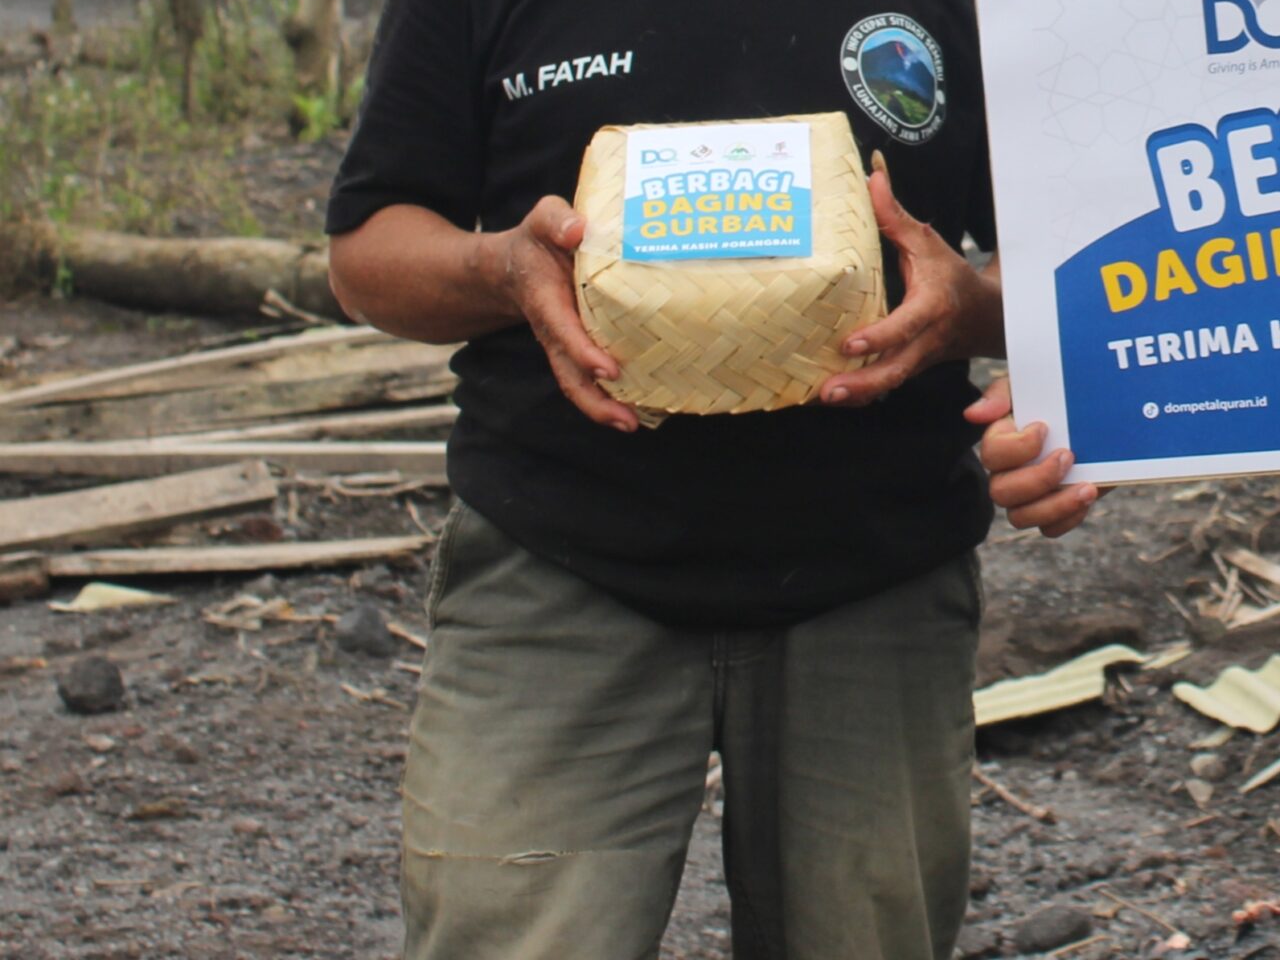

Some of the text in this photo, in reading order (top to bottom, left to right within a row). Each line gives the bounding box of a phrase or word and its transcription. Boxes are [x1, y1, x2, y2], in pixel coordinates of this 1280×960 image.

[847, 32, 863, 52] INFO
[860, 17, 888, 33] CEPAT
[502, 50, 634, 102] M. FATAH
[1207, 60, 1246, 75] Giving
[1247, 58, 1258, 71] is
[852, 83, 899, 134] LUMAJANG
[643, 169, 793, 200] BERBAGI
[642, 192, 794, 219] DAGING
[640, 214, 795, 239] QURBAN
[634, 239, 801, 254] TERIMA KASIH #ORANGBAIK
[1107, 323, 1259, 370] TERIMA
[1164, 396, 1268, 414] dompetalquran.id
